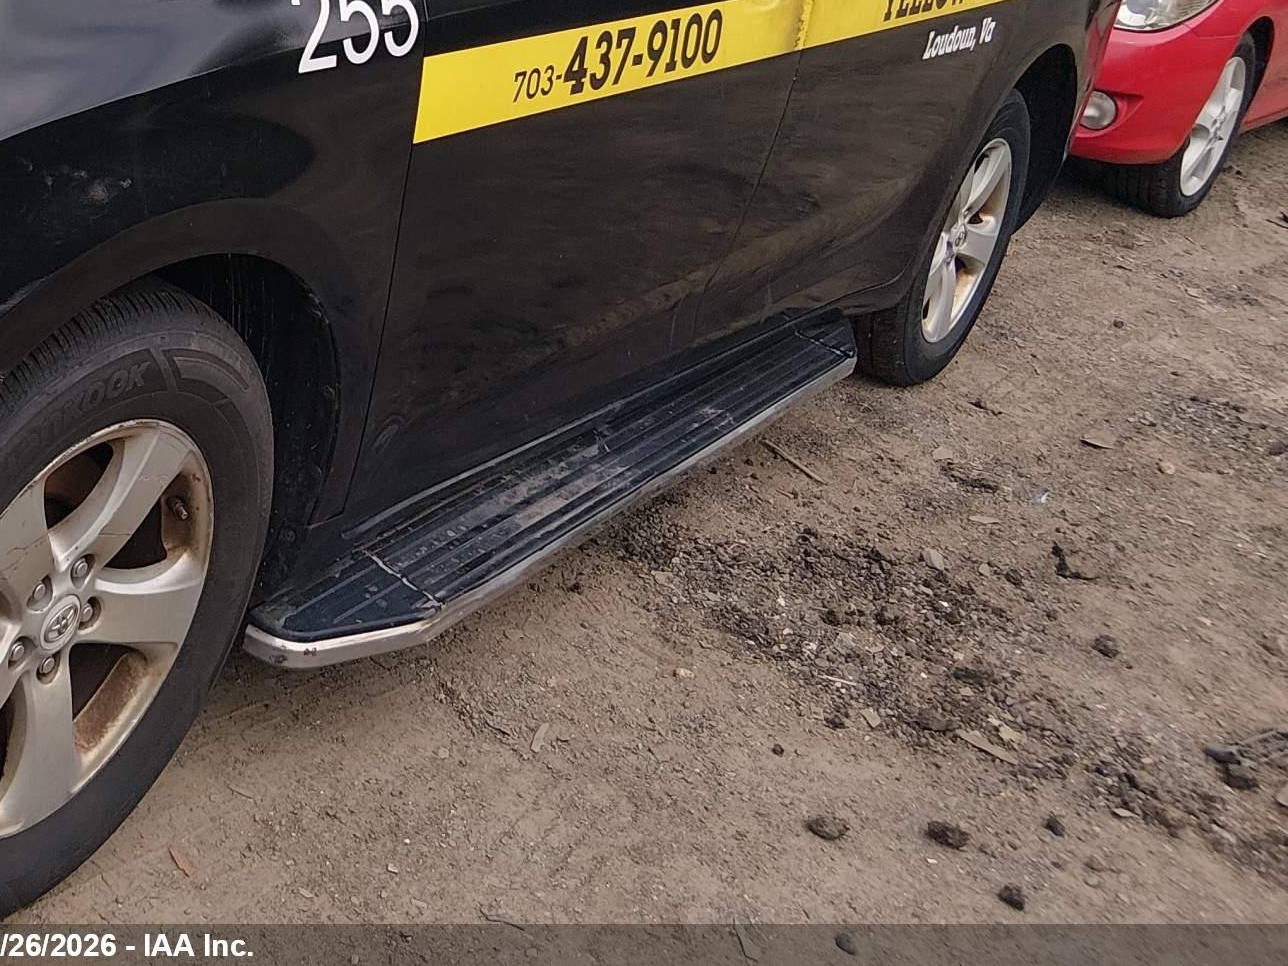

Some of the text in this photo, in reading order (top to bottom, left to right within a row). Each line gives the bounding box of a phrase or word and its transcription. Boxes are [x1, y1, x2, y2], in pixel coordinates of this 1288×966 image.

[512, 8, 724, 103] 703-437-9100
[922, 16, 997, 61] Loudoun, Va
